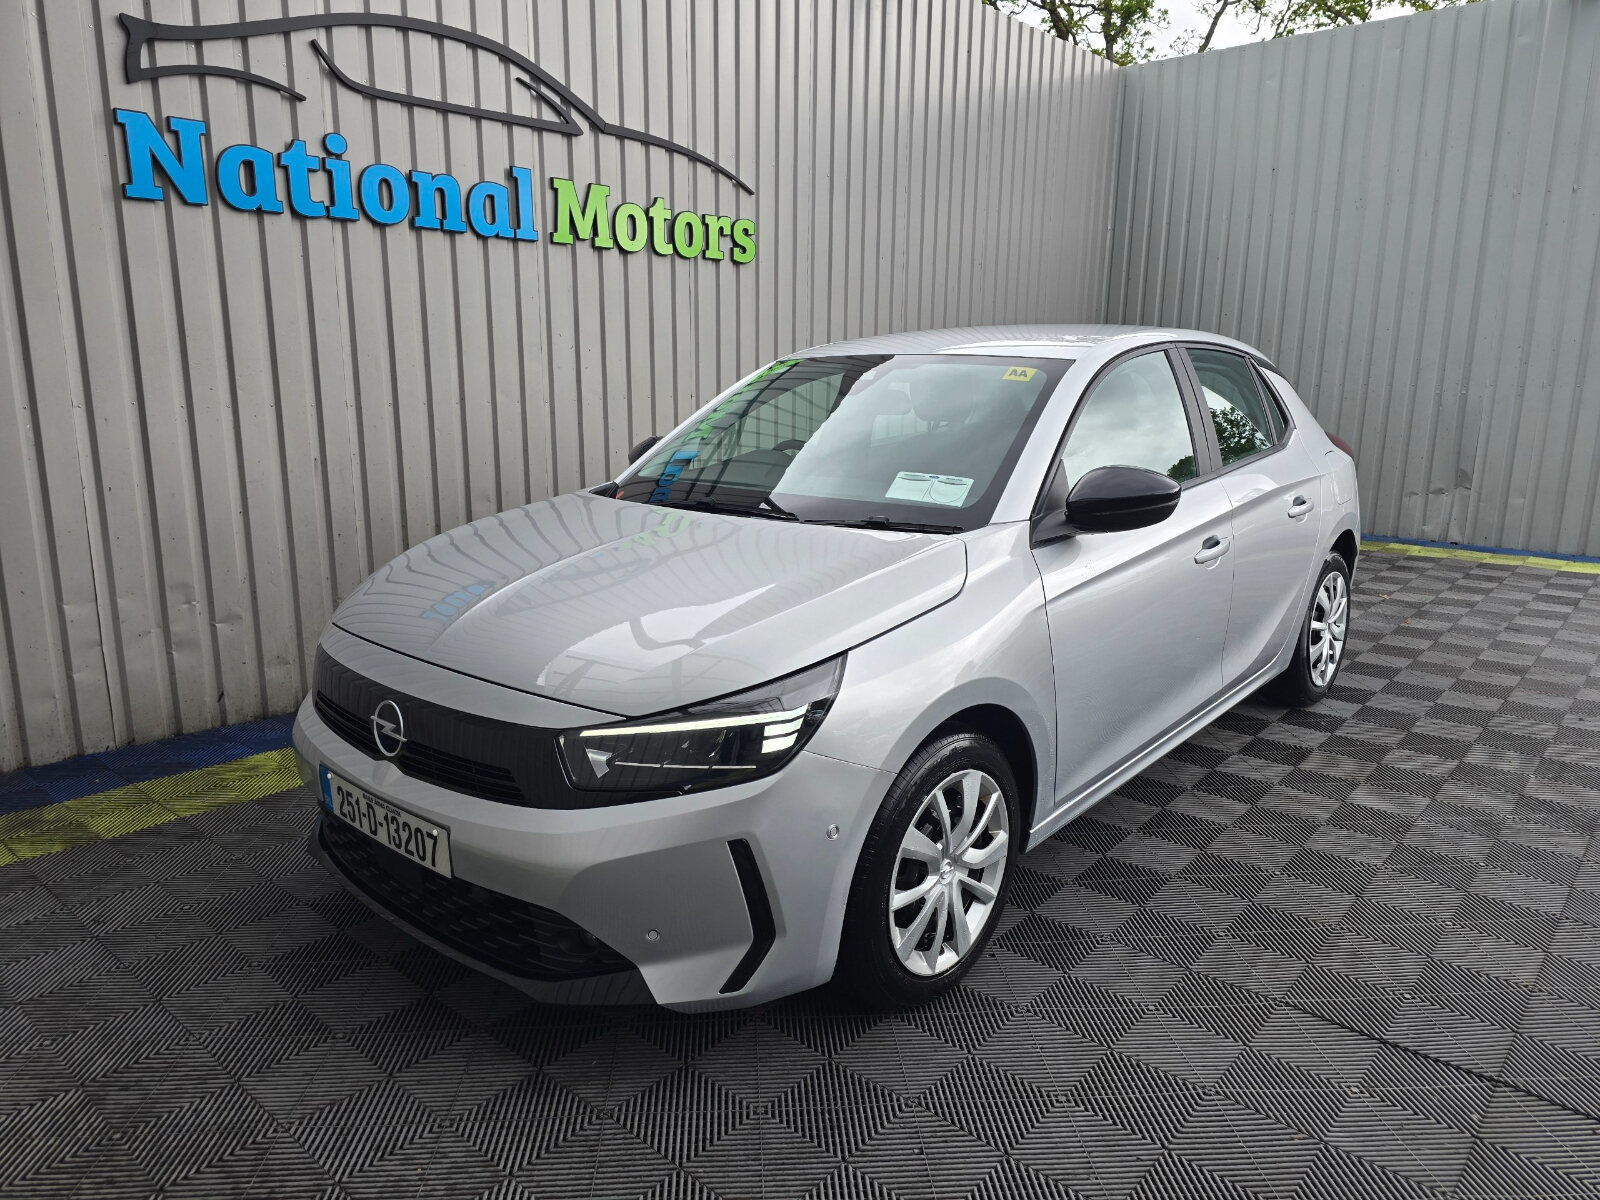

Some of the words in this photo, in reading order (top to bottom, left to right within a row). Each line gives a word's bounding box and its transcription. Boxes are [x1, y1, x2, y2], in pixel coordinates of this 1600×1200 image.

[114, 108, 538, 242] National
[550, 177, 756, 264] Motors
[1008, 368, 1028, 378] AA
[336, 785, 438, 868] 251-D-13207
